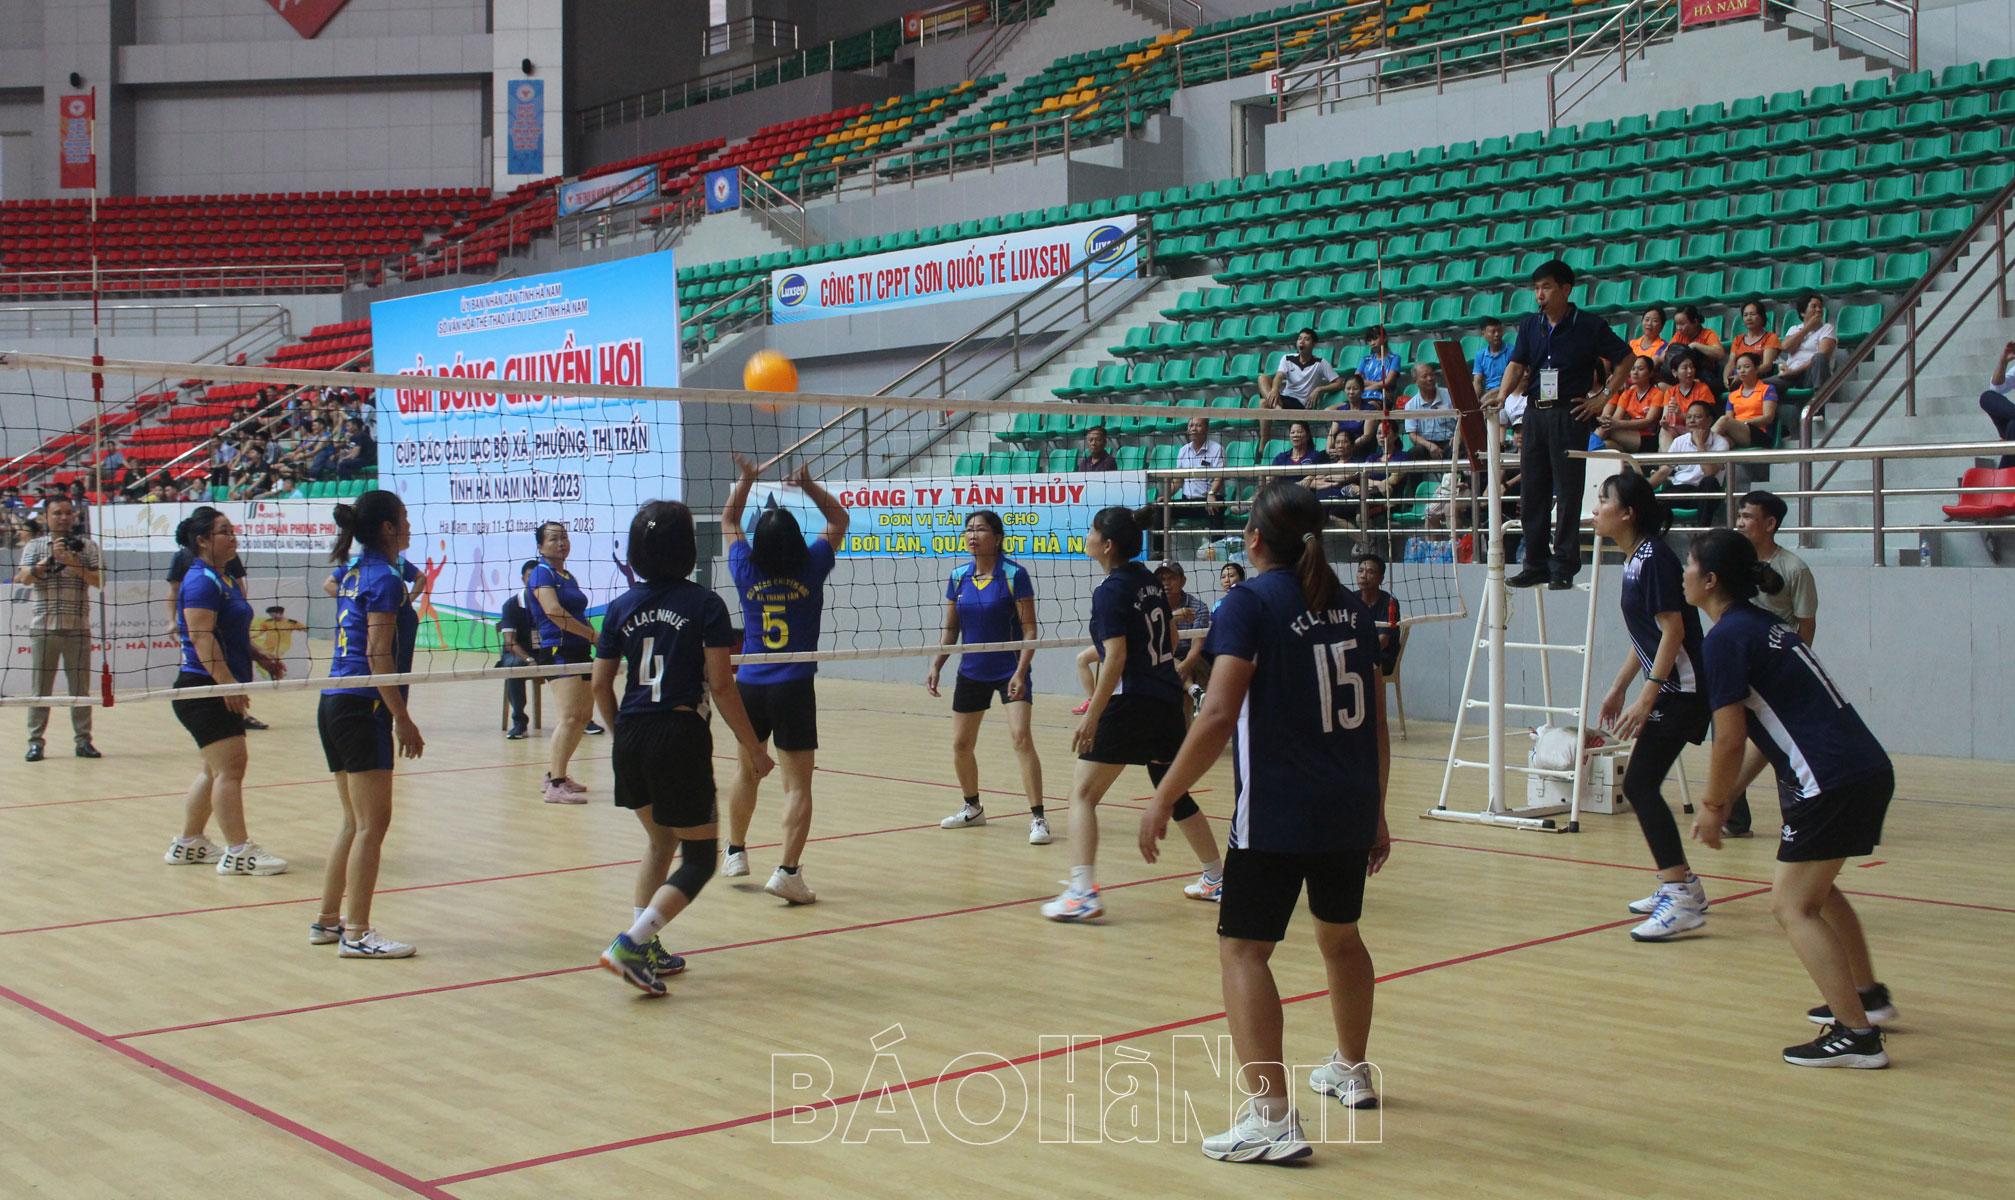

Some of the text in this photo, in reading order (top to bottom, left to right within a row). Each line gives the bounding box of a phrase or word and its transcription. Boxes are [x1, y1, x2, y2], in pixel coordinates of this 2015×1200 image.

[1694, 0, 1748, 17] HÀ NAM
[820, 240, 1071, 307] CÔNG TY CPPT SƠN QUỐC TẾ LUXSEN
[470, 298, 484, 311] BAN
[484, 291, 503, 309] NHÂN
[504, 289, 519, 306] DÂN
[535, 283, 545, 299] HÀ
[546, 283, 562, 297] NAM
[781, 283, 806, 298] Luxsen
[489, 312, 507, 326] THAO
[507, 308, 516, 323] VÀ
[516, 309, 526, 323] DU
[560, 298, 571, 315] HÀ
[572, 299, 588, 314] NAM
[396, 333, 643, 414] GIẢI BÓNG CHUYỀN HƠI
[396, 415, 648, 468] CÚP CÁC CÂU LẠC BỘ XÃ, PHƯỜNG, THỊ TRẤN
[451, 471, 580, 500] TỈNH HÀ NAM NĂM 2023
[840, 477, 1085, 507] CÔNG TY TÂN THỦY
[290, 524, 317, 534] PHONG
[492, 519, 514, 533] 11-13
[516, 518, 538, 535] tháng
[573, 517, 595, 532] 2023
[916, 513, 932, 529] VỊ
[935, 510, 962, 525] TÀI
[1003, 513, 1040, 526] CHO
[851, 536, 880, 552] BƠI
[886, 533, 926, 556] LẶN,
[1003, 535, 1028, 557] ỢT
[1033, 532, 1061, 554] HÀ
[622, 622, 635, 637] FC
[634, 610, 656, 627] LẠC
[762, 605, 789, 650] 5
[1144, 607, 1174, 667] 12
[1290, 615, 1310, 637] FC
[126, 640, 146, 650] HÀ
[639, 636, 665, 703] 4
[1313, 638, 1366, 733] 15
